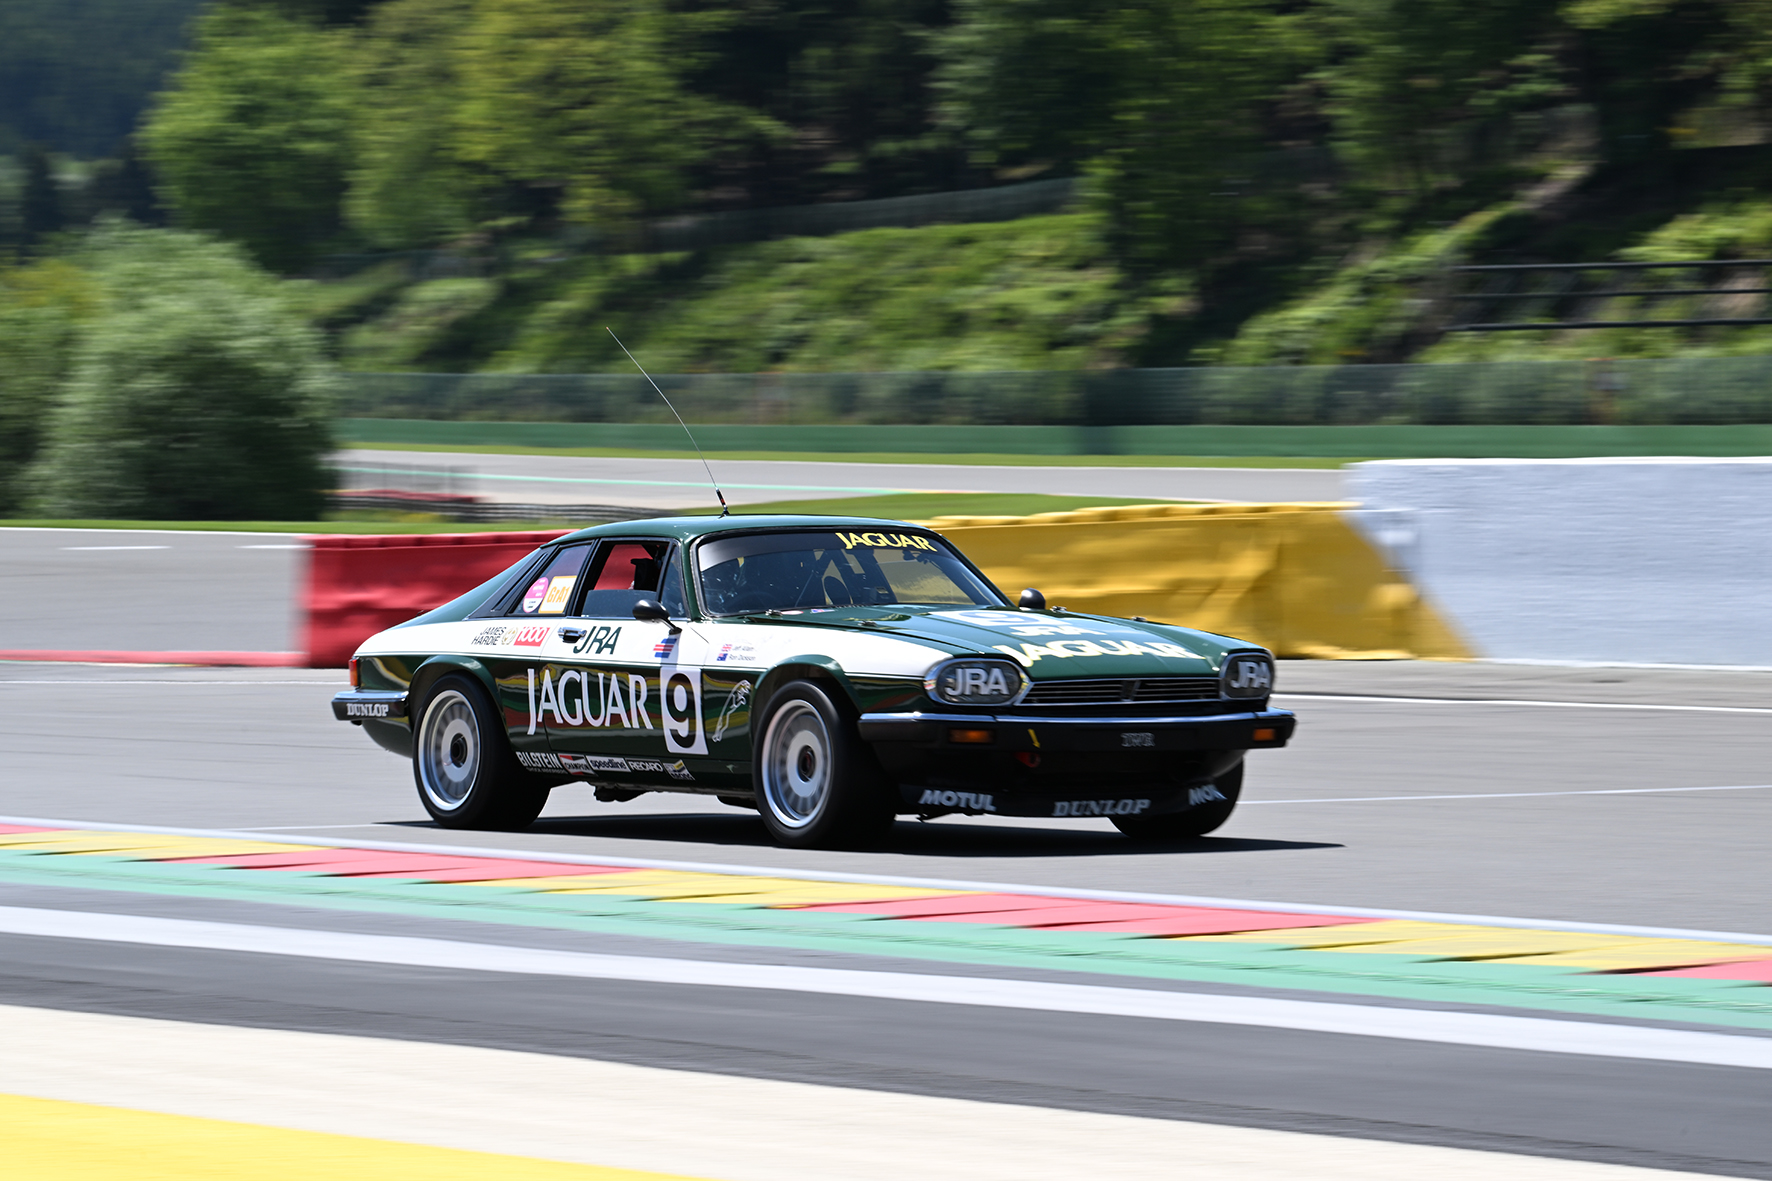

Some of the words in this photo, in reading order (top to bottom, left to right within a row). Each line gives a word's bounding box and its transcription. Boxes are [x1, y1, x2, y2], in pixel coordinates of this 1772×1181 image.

[836, 532, 937, 552] JAGUAR
[480, 627, 507, 636] JAMES
[518, 626, 548, 642] 1000
[1010, 626, 1106, 636] JRA
[471, 636, 501, 646] HARDIE
[573, 626, 622, 655] JRA
[992, 640, 1206, 667] JAGUAR
[945, 667, 1010, 696] JRA
[1230, 661, 1270, 689] JRA
[346, 703, 389, 717] DUNLOP
[526, 668, 654, 735] JAGUAR
[666, 673, 697, 749] 9
[516, 751, 563, 769] BILSTEIN
[564, 761, 591, 771] CHAMPION
[591, 759, 627, 770] speedline
[629, 761, 664, 772] RECARO
[919, 789, 997, 812] MOTUL
[1052, 799, 1151, 816] DUNLOP
